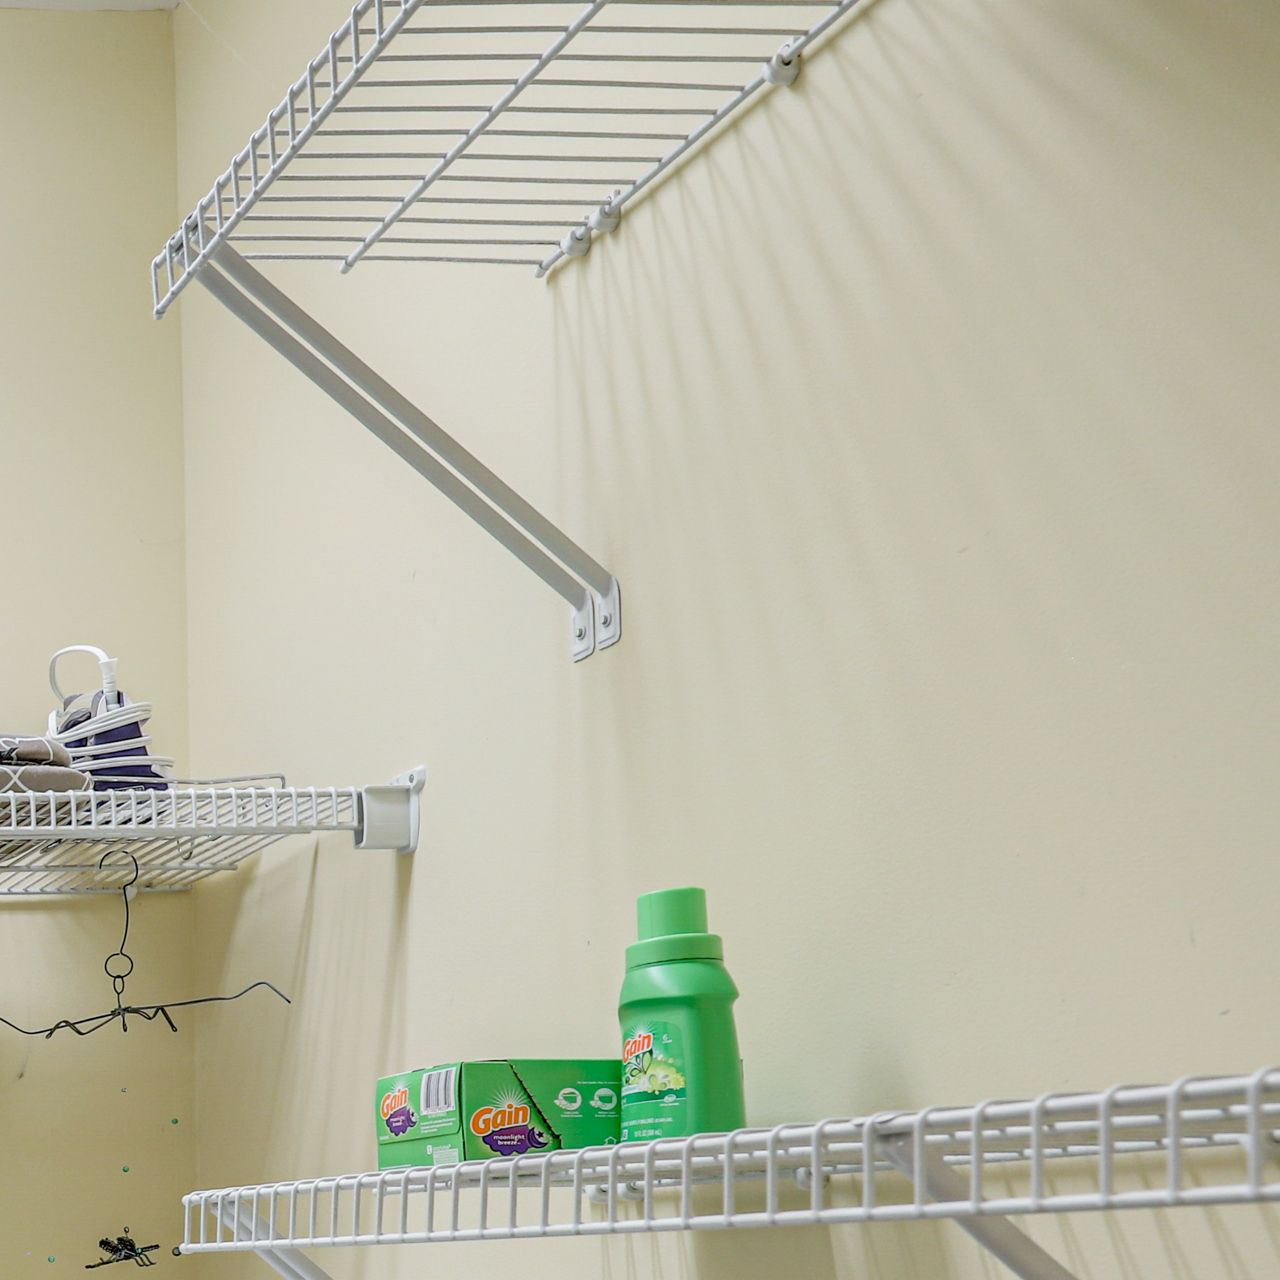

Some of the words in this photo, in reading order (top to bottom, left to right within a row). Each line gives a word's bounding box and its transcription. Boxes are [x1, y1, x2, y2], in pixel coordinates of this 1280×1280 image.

[623, 1033, 653, 1063] Gain
[381, 1088, 408, 1119] Gain
[471, 1103, 530, 1135] Gain
[493, 1134, 525, 1143] moonlight
